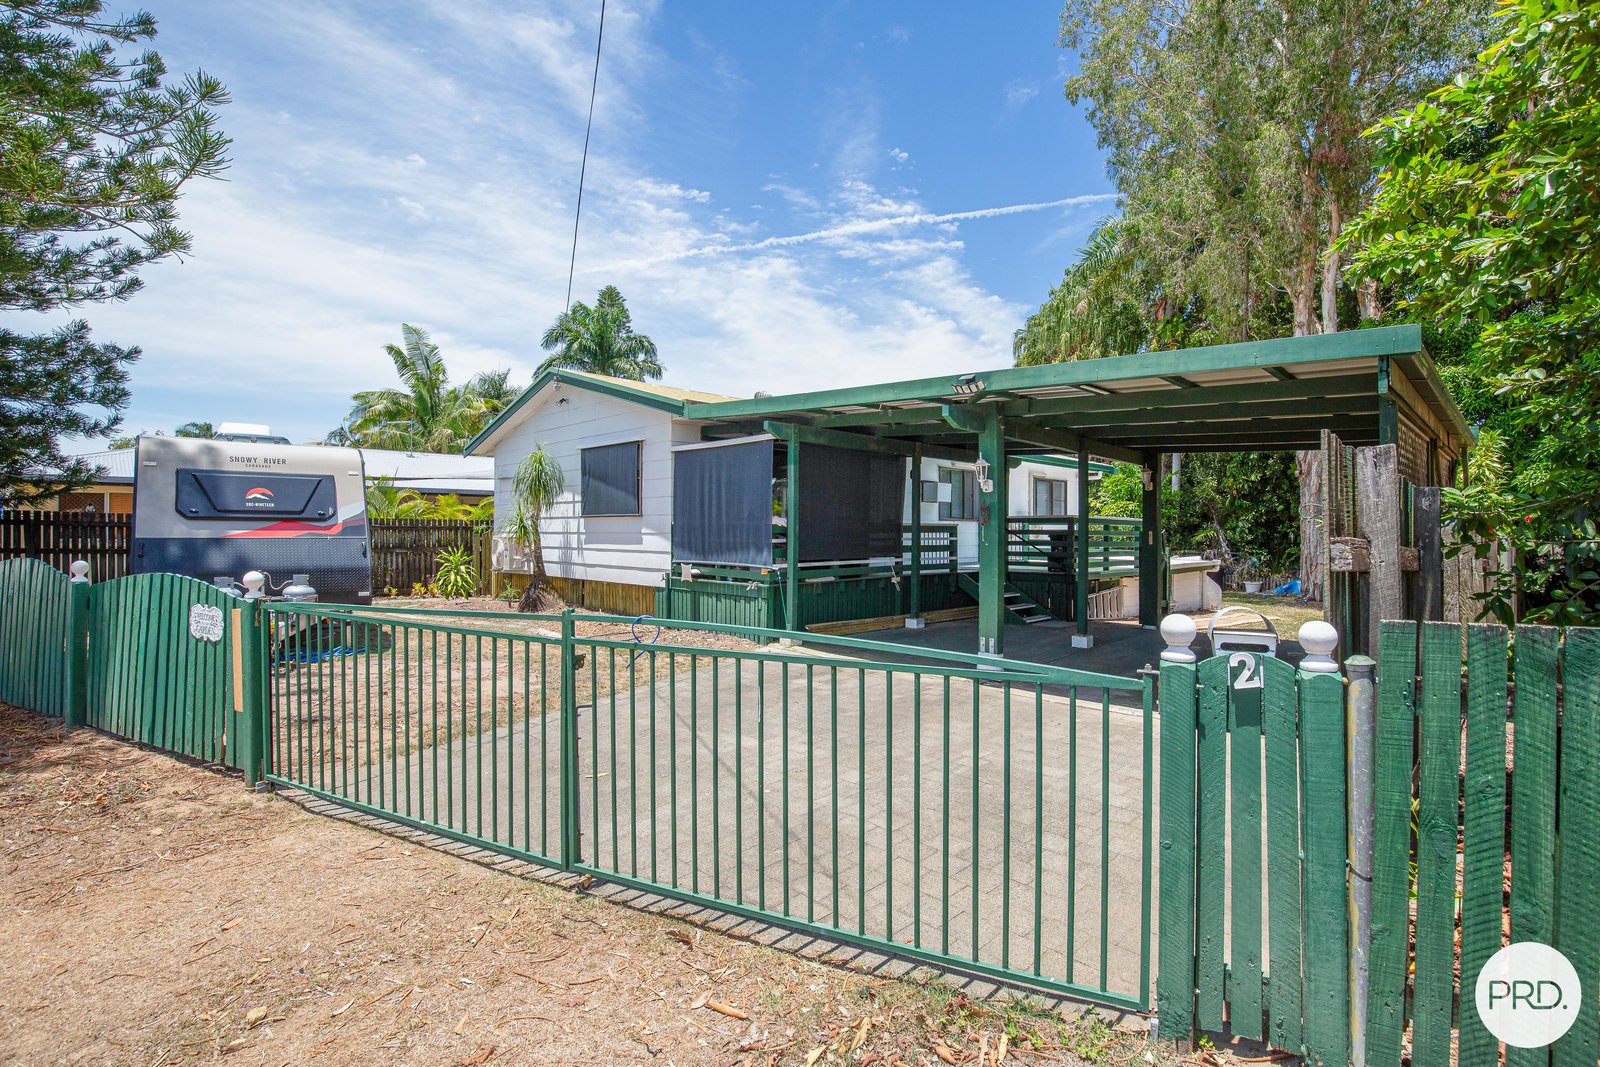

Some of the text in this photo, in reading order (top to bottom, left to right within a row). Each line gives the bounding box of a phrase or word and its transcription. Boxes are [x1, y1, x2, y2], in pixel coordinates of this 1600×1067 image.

[229, 455, 287, 465] SNOWY RIVER
[1229, 652, 1261, 690] 2
